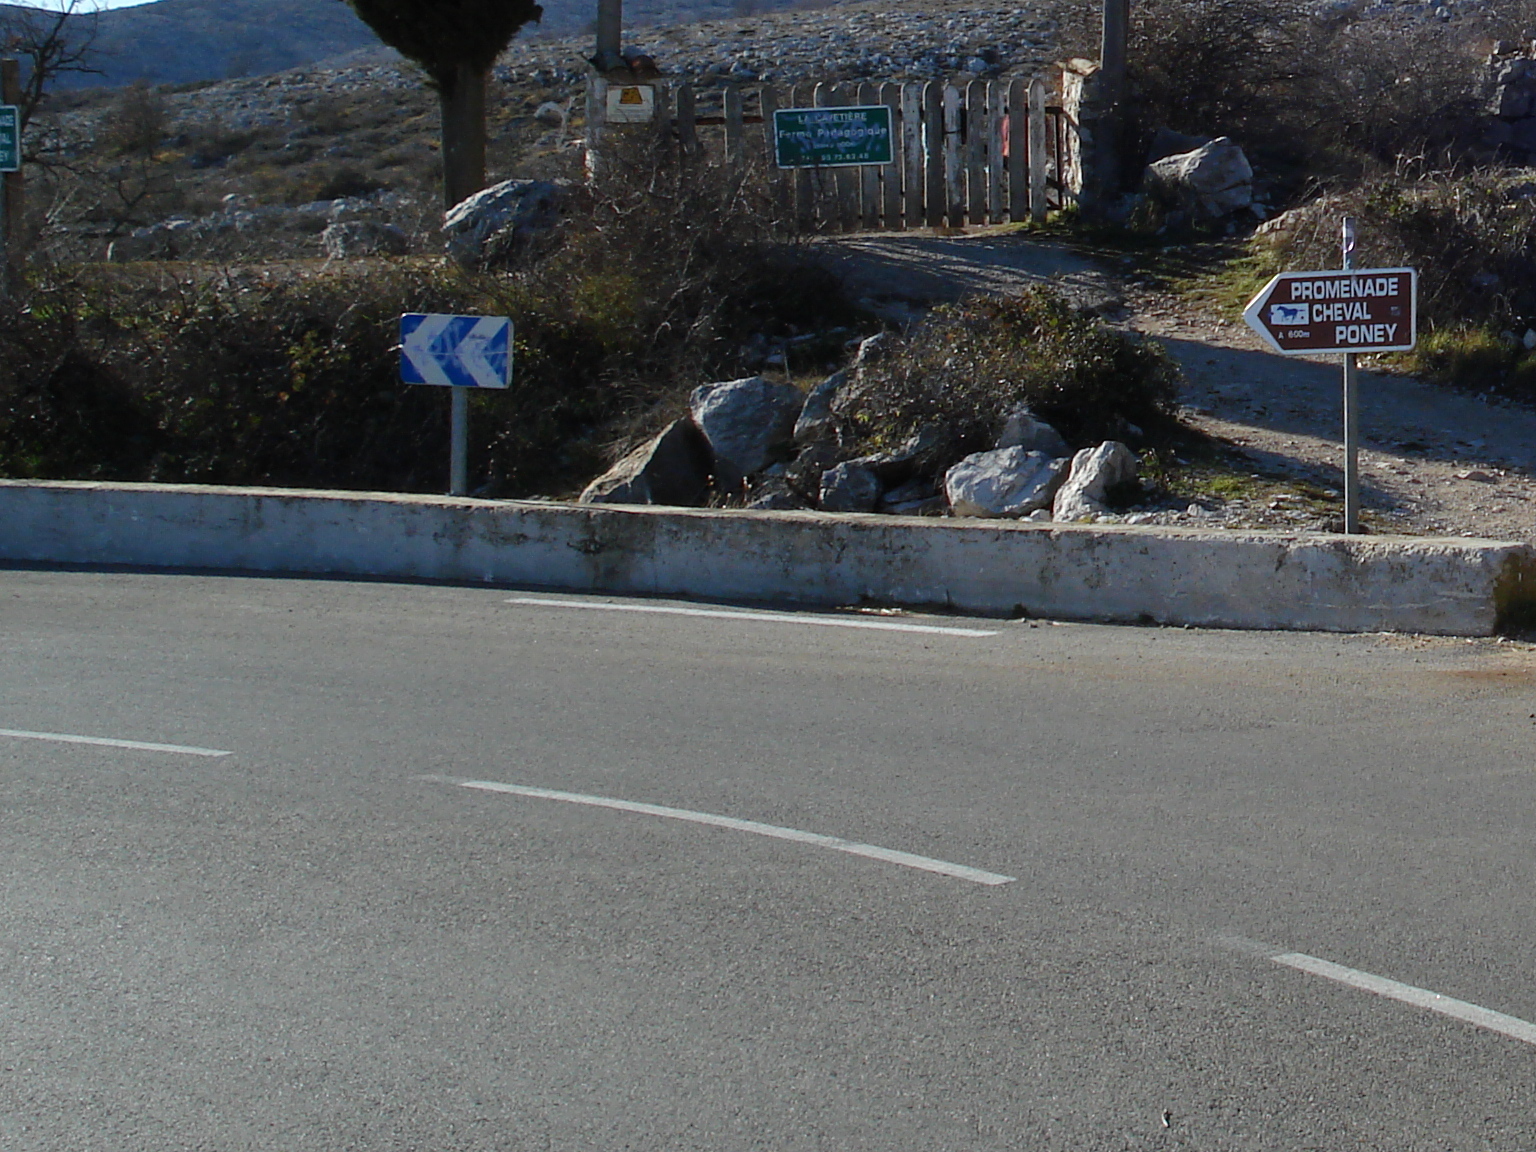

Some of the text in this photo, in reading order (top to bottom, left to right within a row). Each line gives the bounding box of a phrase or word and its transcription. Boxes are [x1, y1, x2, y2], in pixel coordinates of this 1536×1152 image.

[1291, 278, 1399, 300] PROMENADE
[1312, 302, 1371, 322] CHEVAL
[1335, 323, 1398, 344] PONEY
